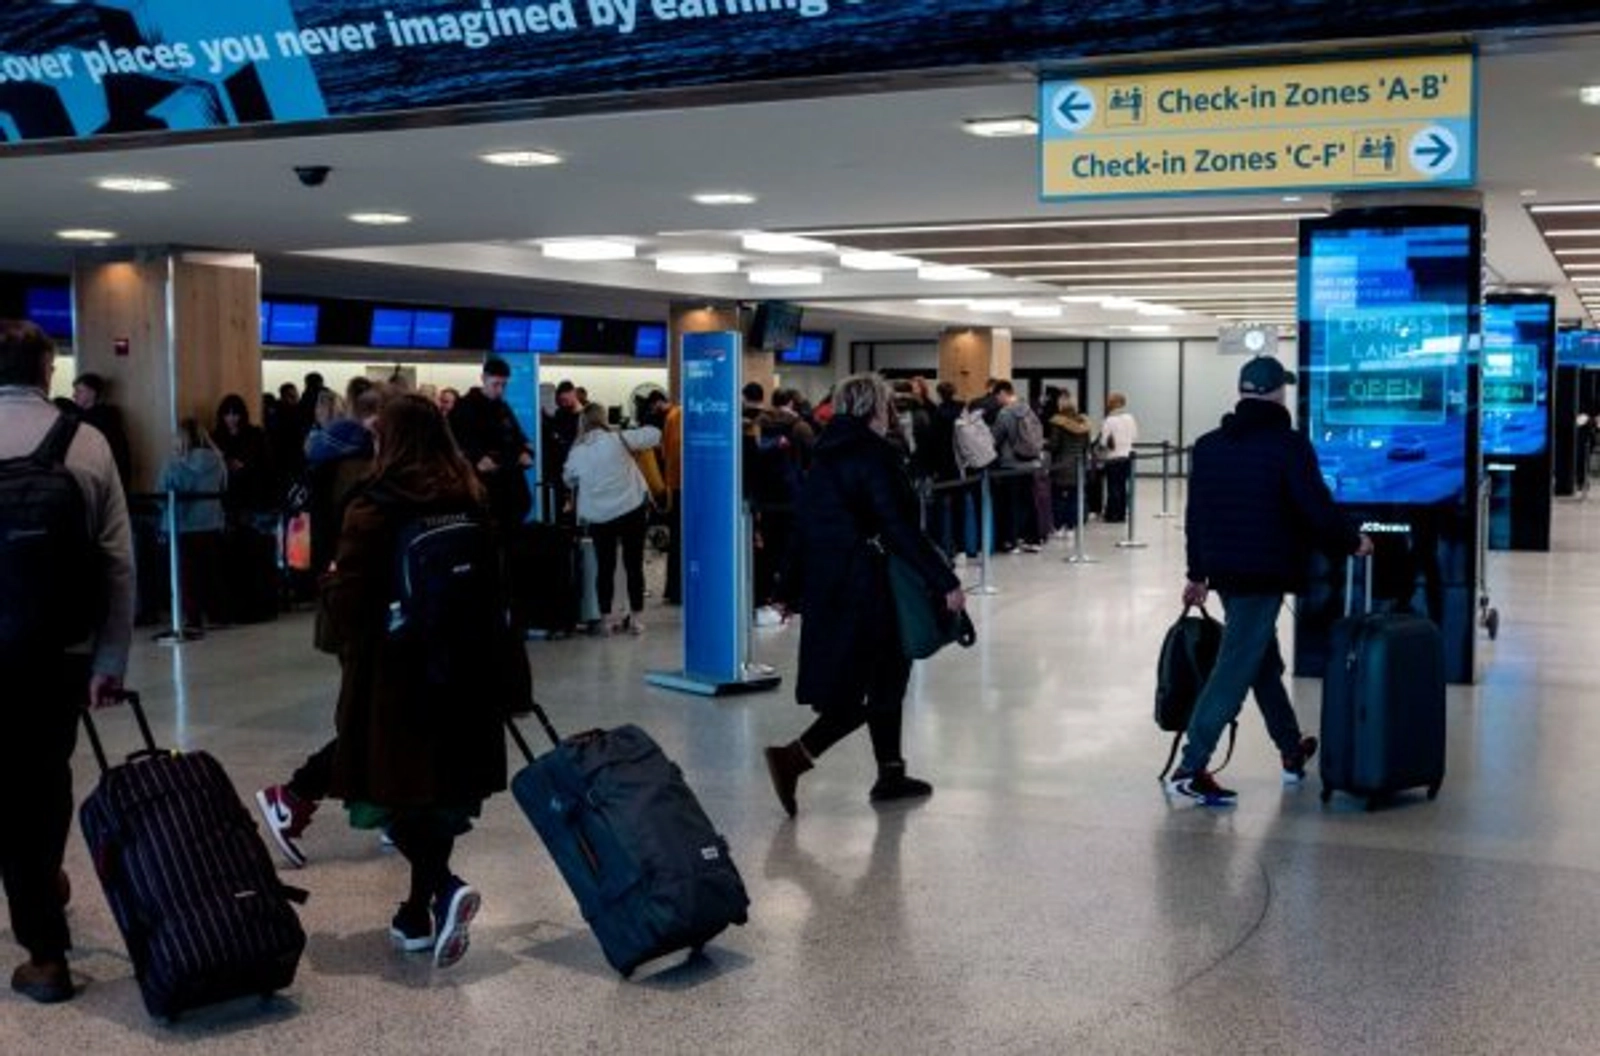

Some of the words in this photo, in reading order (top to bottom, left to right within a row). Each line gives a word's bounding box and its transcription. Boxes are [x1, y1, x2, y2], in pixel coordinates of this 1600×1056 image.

[81, 39, 196, 84] places
[200, 35, 269, 73] you
[277, 24, 376, 57] never
[386, 0, 577, 47] imagined
[590, 0, 638, 33] by
[652, 0, 828, 20] earng
[1157, 85, 1277, 114] Check-in
[1285, 81, 1370, 108] Zones
[1379, 74, 1449, 101] 'A-B'
[1071, 147, 1186, 178] Check-in
[1194, 146, 1277, 173] Zones
[1285, 142, 1346, 169] 'C-F'
[1341, 317, 1433, 334] EXPRESS
[1348, 377, 1423, 400] OPEN
